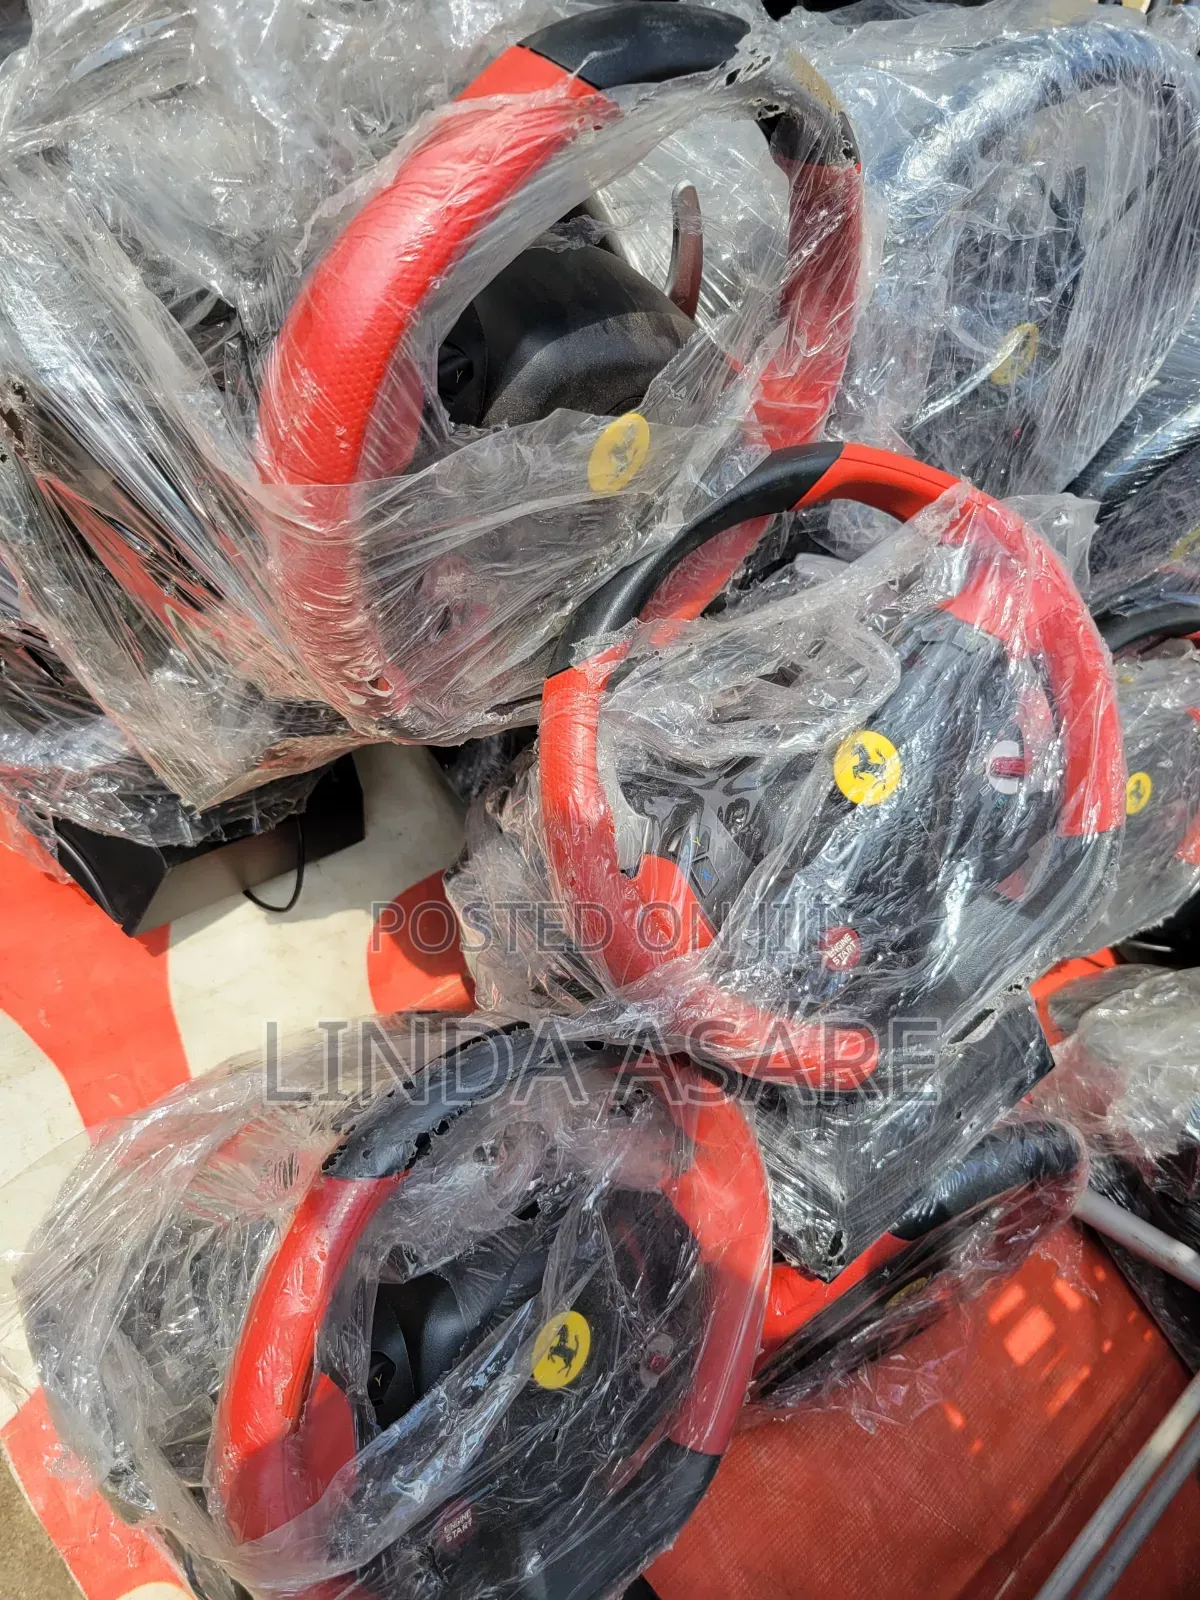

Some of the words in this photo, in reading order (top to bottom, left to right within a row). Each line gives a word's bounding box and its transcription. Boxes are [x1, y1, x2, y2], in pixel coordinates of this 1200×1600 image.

[827, 932, 852, 958] ENGINE
[832, 940, 857, 965] START
[445, 1517, 473, 1543] START
